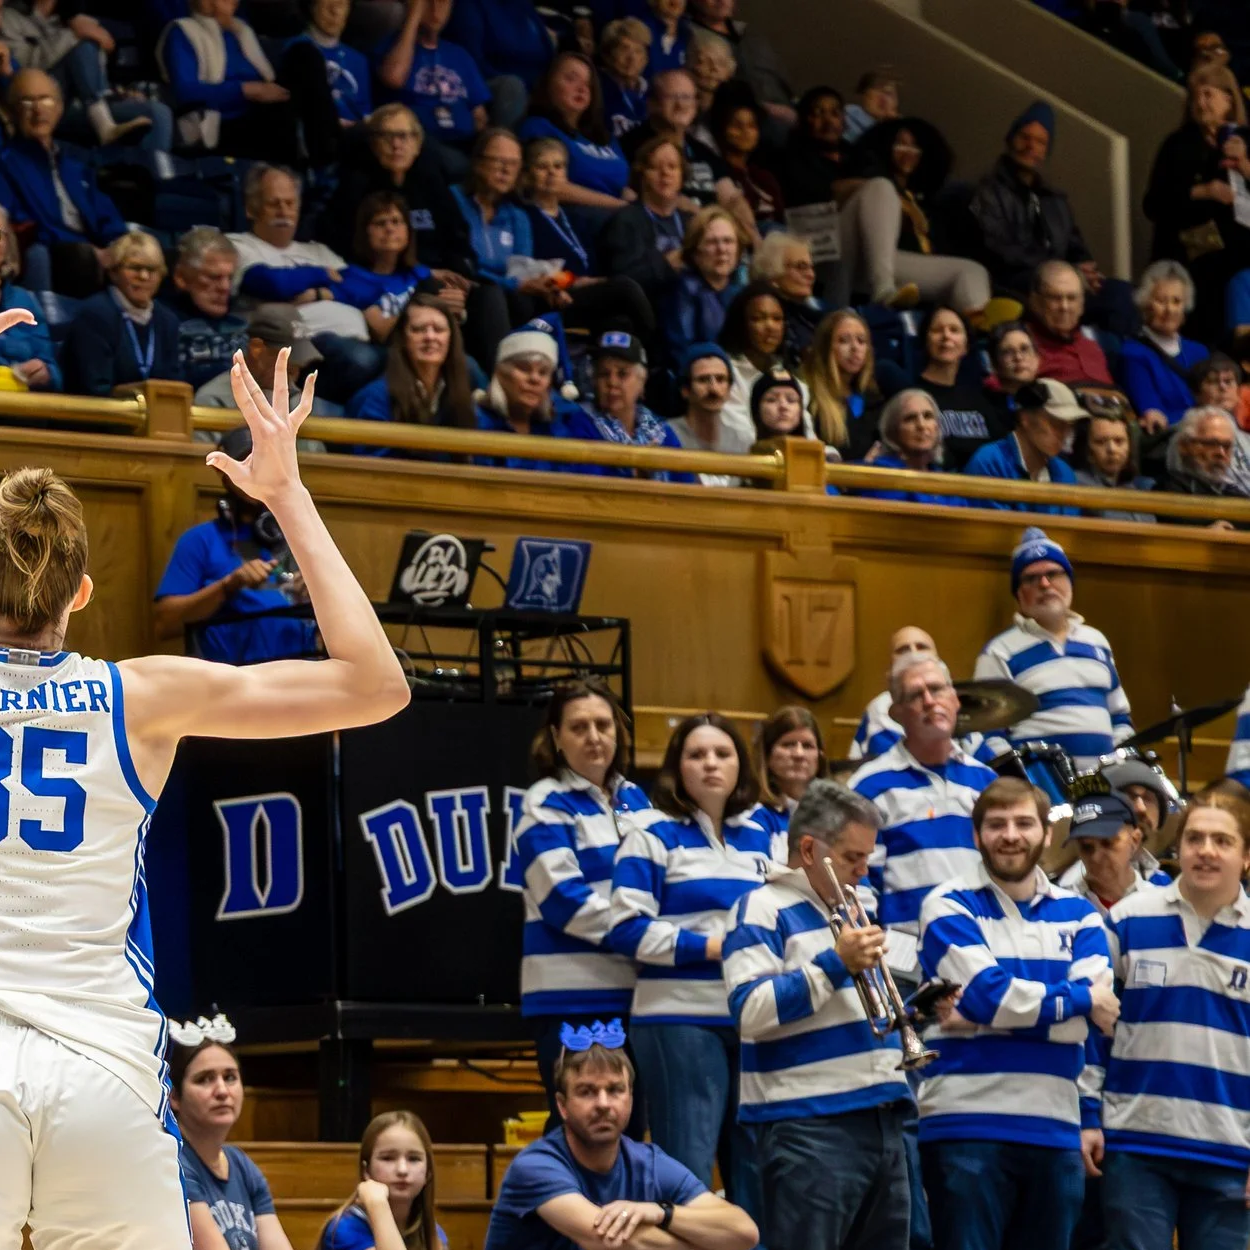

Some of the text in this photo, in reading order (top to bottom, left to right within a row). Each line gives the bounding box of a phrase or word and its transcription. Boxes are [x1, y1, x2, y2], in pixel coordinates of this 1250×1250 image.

[780, 592, 844, 668] 17
[359, 785, 528, 916] DU
[210, 1199, 258, 1238] DUK
